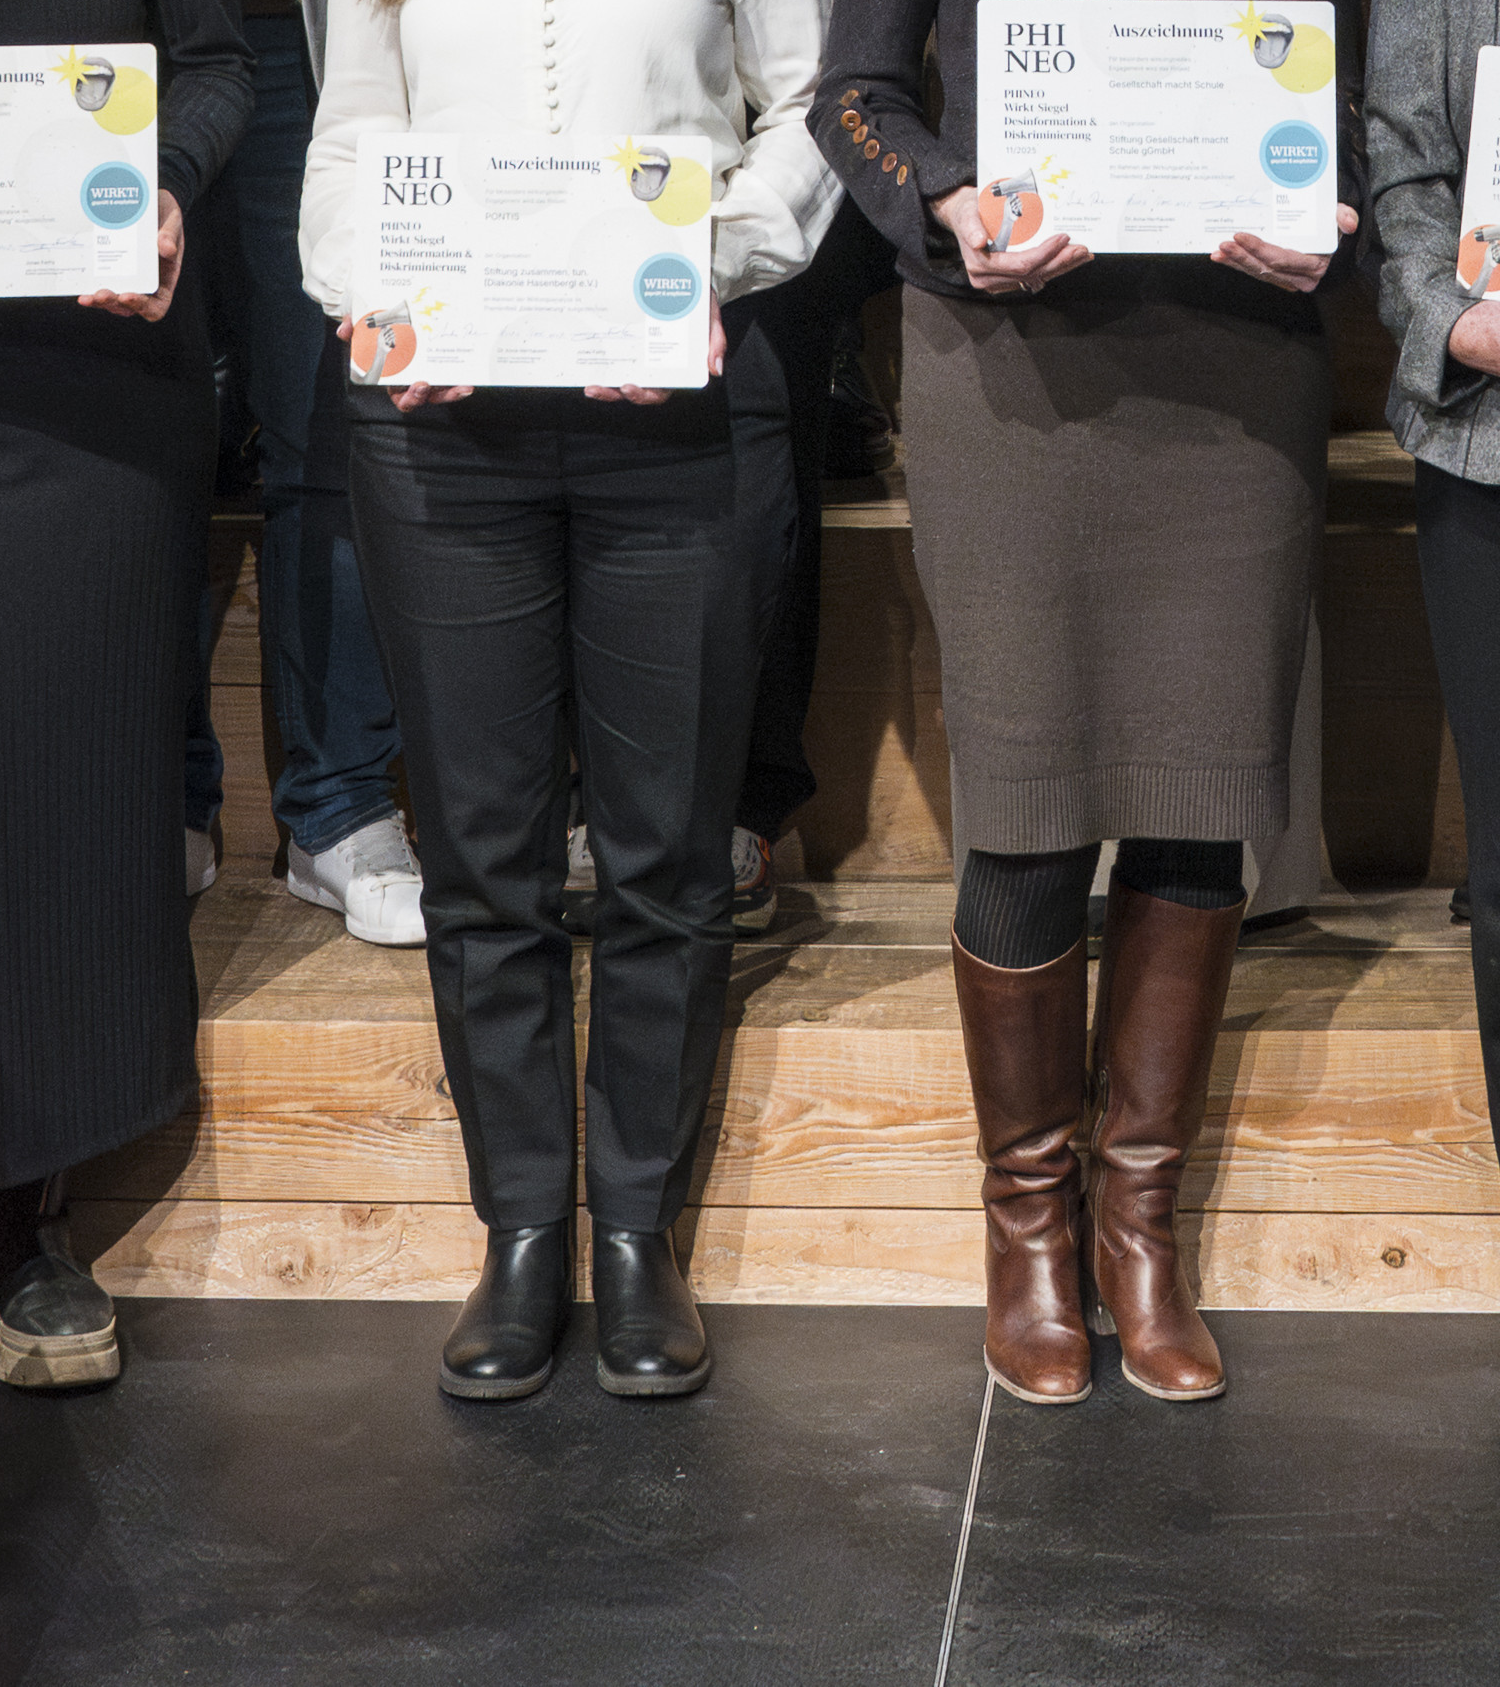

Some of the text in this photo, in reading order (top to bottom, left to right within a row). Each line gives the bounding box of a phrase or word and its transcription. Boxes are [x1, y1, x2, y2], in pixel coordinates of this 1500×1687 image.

[1005, 23, 1064, 46] PHI
[1110, 23, 1223, 39] Auszeichnung
[1005, 50, 1075, 72] NEO
[1108, 79, 1224, 89] Gesellschaft macht Schule
[1269, 145, 1317, 160] WIRKT!
[383, 155, 442, 178] PHI
[488, 156, 600, 172] Auszeichnung
[90, 186, 138, 200] WIRKT!
[383, 182, 452, 205] NEO
[484, 211, 519, 221] PONTIS
[643, 278, 691, 292] WIRKT!
